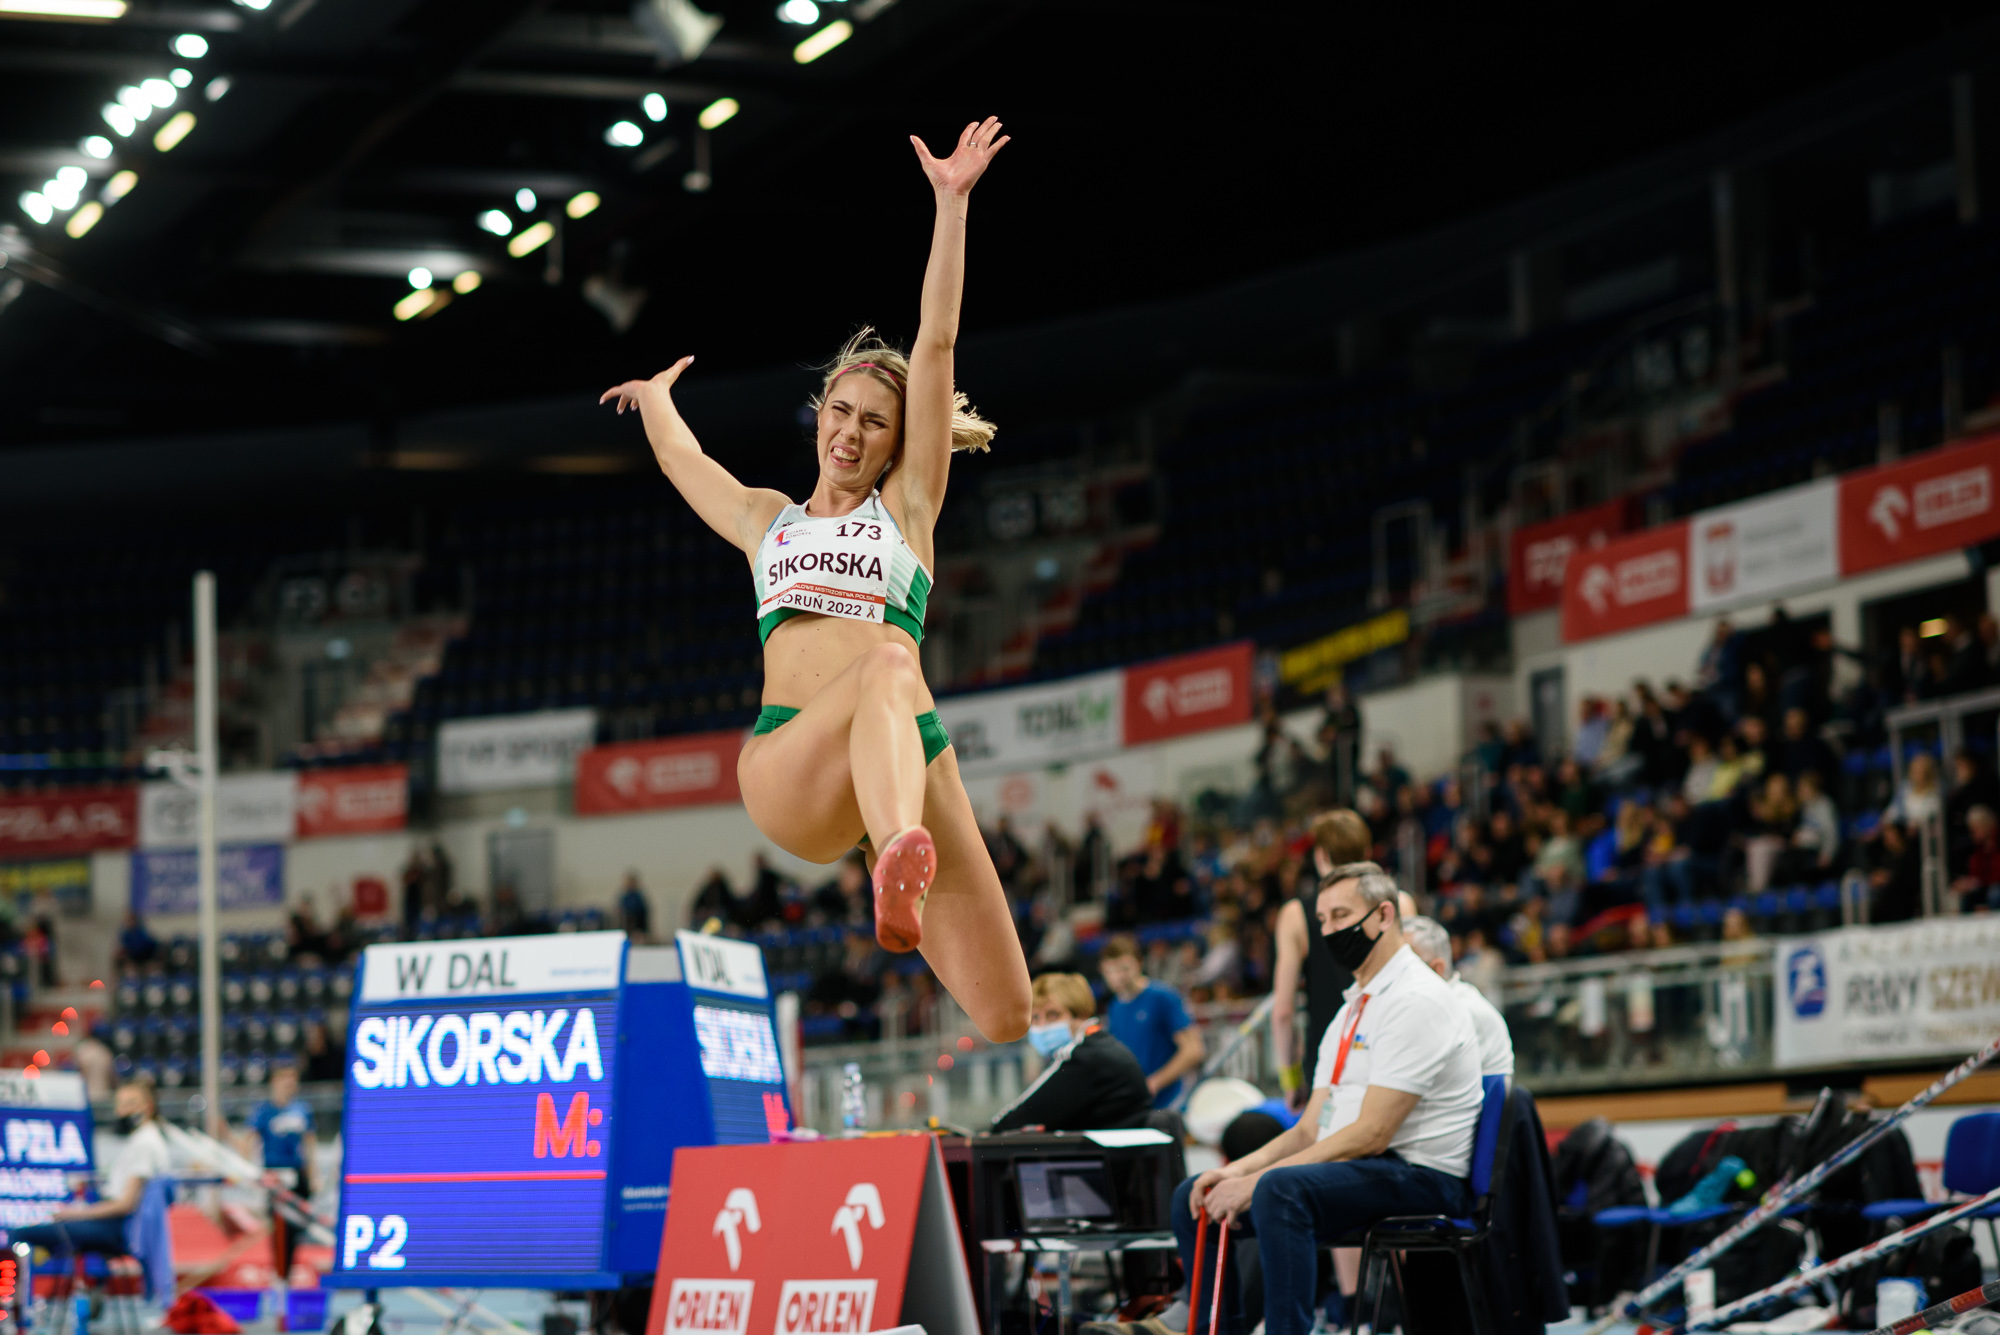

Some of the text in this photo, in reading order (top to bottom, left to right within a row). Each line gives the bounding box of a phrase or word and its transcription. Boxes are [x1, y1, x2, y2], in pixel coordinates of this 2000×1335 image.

[836, 522, 882, 541] 173
[768, 552, 883, 586] SIKORSKA
[814, 585, 855, 599] MISTRZOSTWA
[855, 593, 876, 602] POLSKI
[826, 600, 863, 617] 2022
[396, 950, 517, 992] W DAL
[352, 1007, 604, 1089] SIKORSKA
[4, 1117, 89, 1166] PZLA
[533, 1091, 603, 1159] M:
[673, 1289, 867, 1334] ORLEN ORLEN
